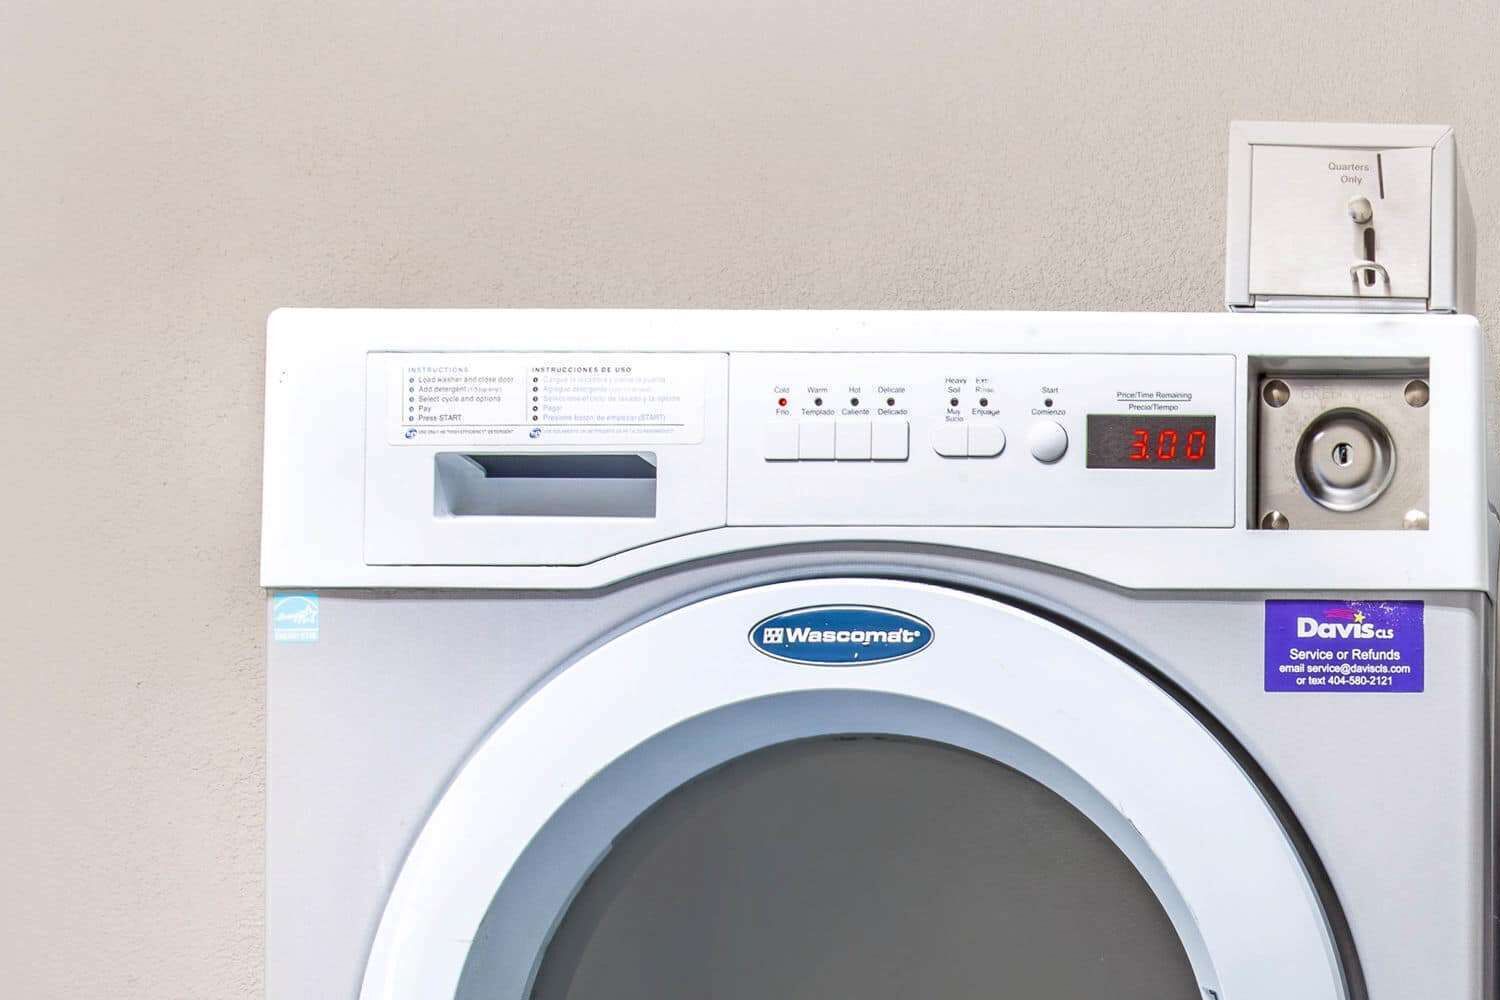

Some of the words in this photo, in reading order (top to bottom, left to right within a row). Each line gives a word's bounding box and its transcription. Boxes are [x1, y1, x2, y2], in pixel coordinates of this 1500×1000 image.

[1328, 162, 1370, 172] Quarters
[1340, 176, 1362, 185] Only
[434, 386, 467, 394] detergent
[878, 386, 905, 394] Delicate
[1156, 392, 1192, 400] Remaining
[1129, 429, 1207, 460] 3.00
[1297, 616, 1374, 638] Davis
[1376, 629, 1394, 639] CLS
[786, 627, 914, 643] Wascomat
[1289, 649, 1333, 660] Service
[1336, 650, 1348, 660] or
[1352, 649, 1400, 660] Refunds
[1279, 664, 1305, 673] email
[1307, 664, 1410, 675] service@daviscls.com
[1308, 676, 1326, 685] text
[1328, 676, 1392, 685] 404-580-2121
